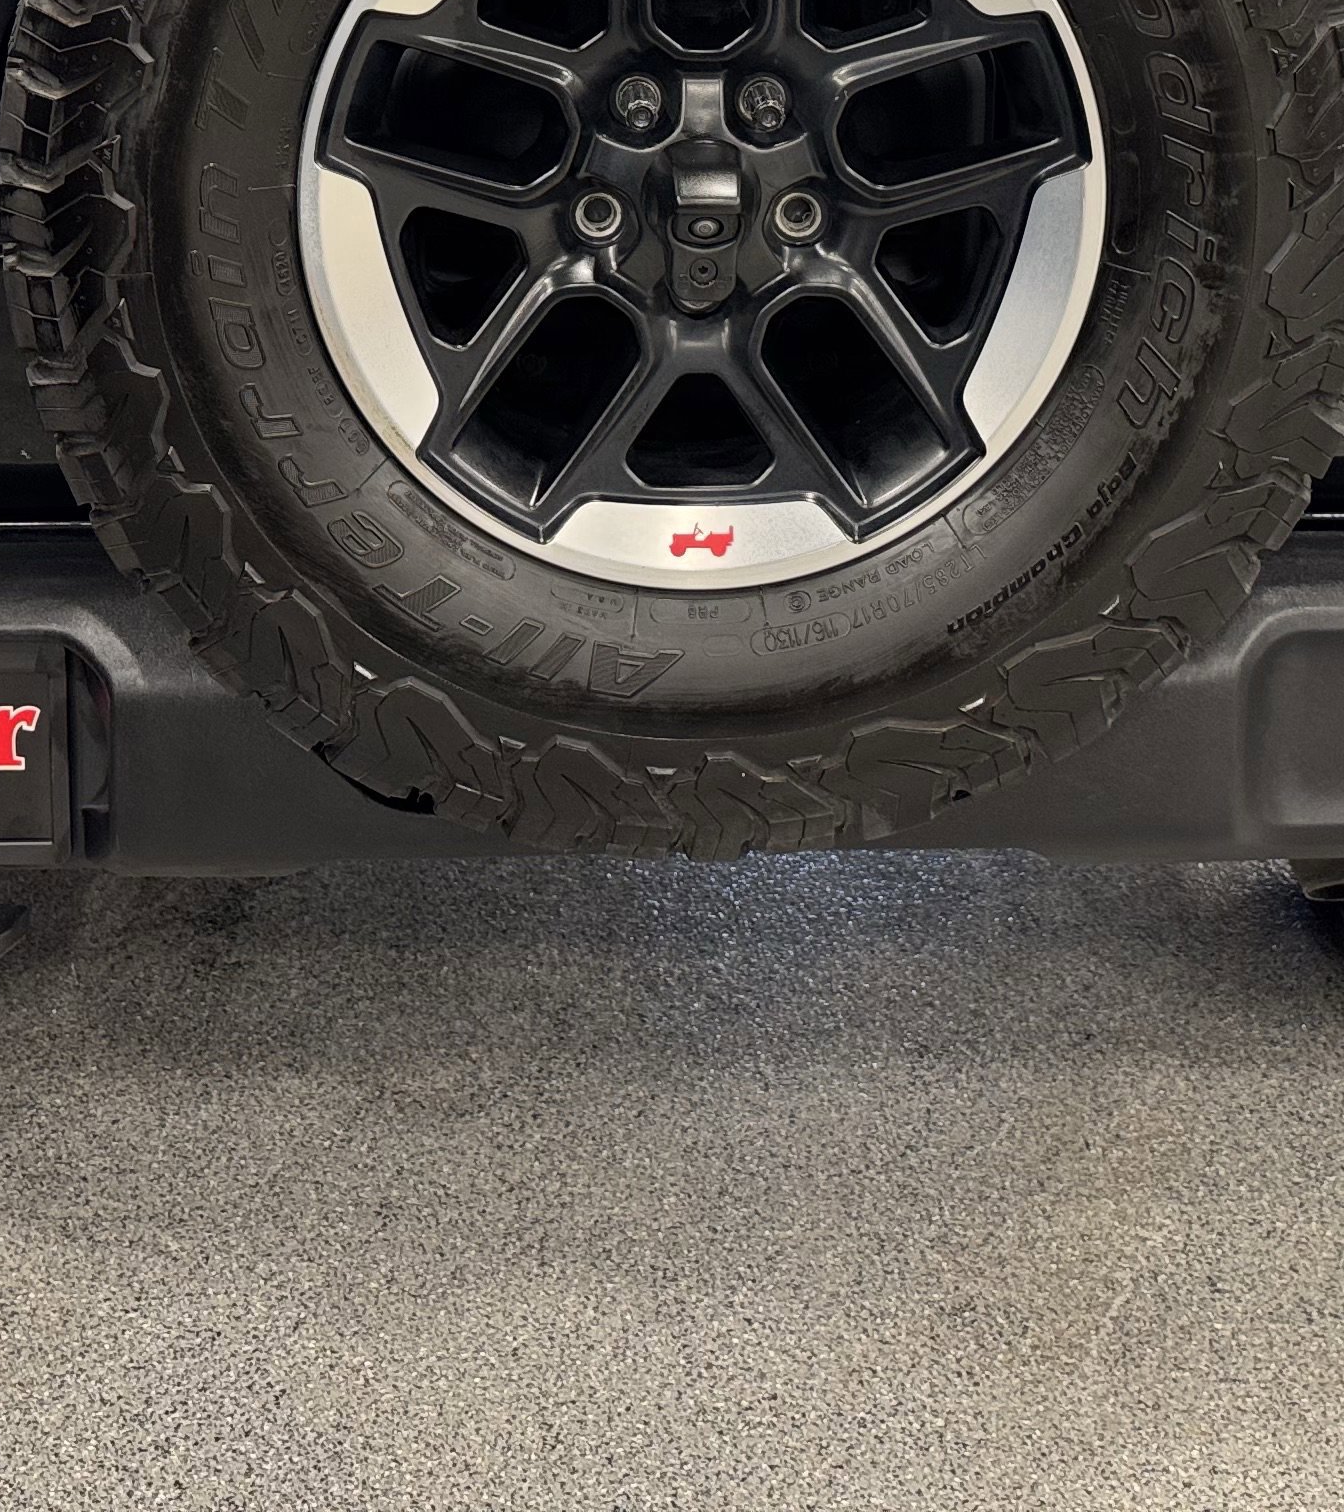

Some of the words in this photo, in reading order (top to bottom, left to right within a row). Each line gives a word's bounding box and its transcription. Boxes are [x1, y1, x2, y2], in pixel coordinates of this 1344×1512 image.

[1086, 451, 1138, 519] Baja
[886, 540, 935, 576] LOAD
[947, 521, 1085, 634] Champion
[817, 568, 881, 603] RANGE
[852, 543, 988, 629] LT285/70R17
[764, 617, 840, 653] 116/113Q
